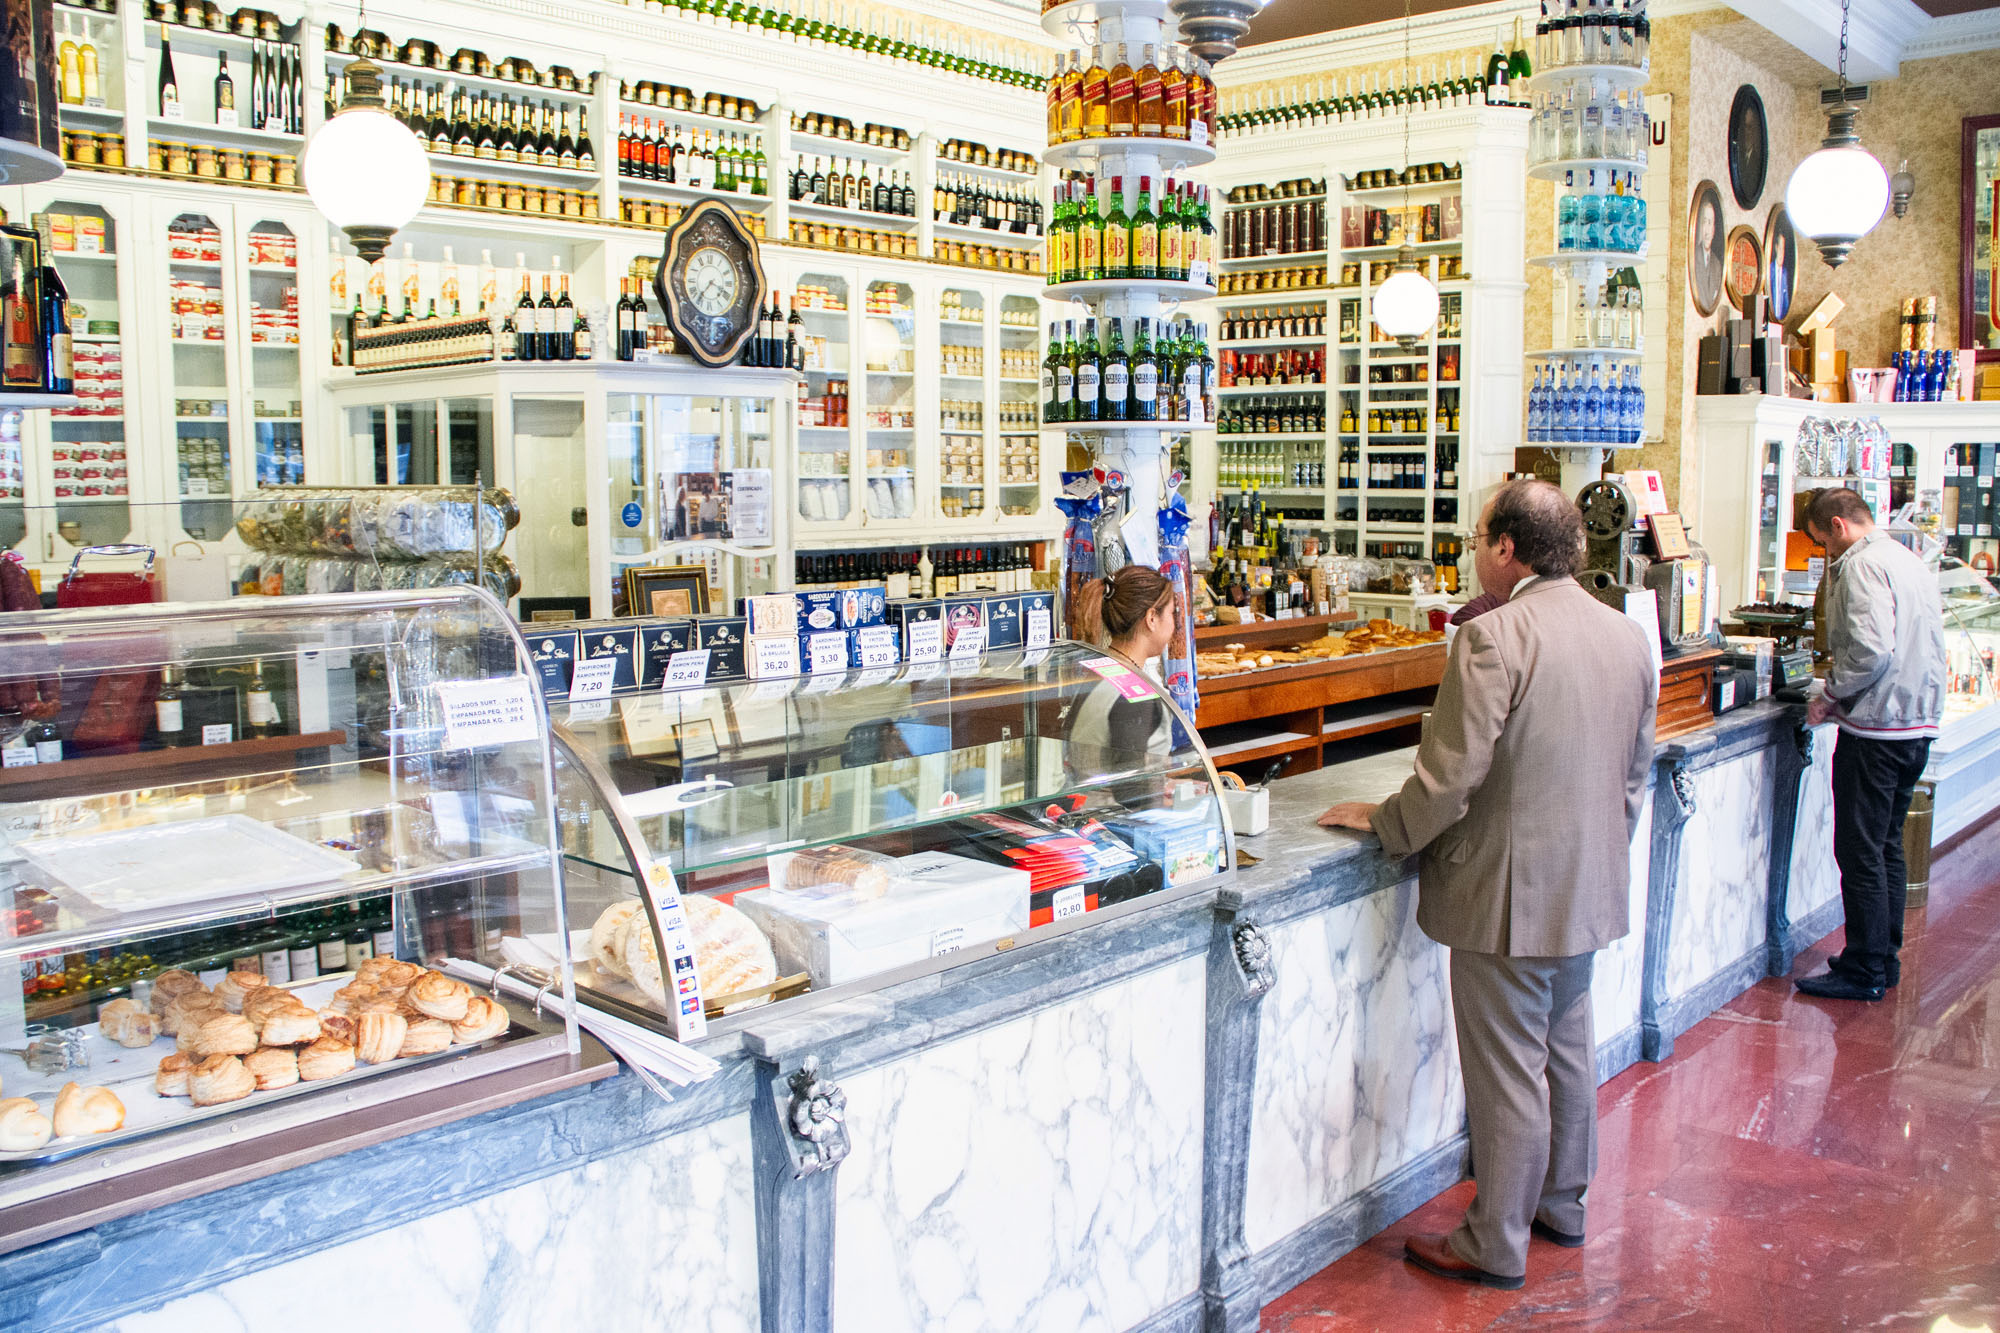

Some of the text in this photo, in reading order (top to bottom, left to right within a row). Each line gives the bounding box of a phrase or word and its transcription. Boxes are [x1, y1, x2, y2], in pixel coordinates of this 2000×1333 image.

[820, 654, 838, 664] 3,30
[869, 653, 888, 663] 5,20
[764, 660, 789, 671] 36,20
[672, 670, 700, 680] 52,40
[581, 682, 602, 692] 7,20
[452, 718, 491, 729] EMPANADA
[662, 896, 676, 905] VISA
[1057, 903, 1081, 917] 12,80
[668, 917, 682, 926] VISA
